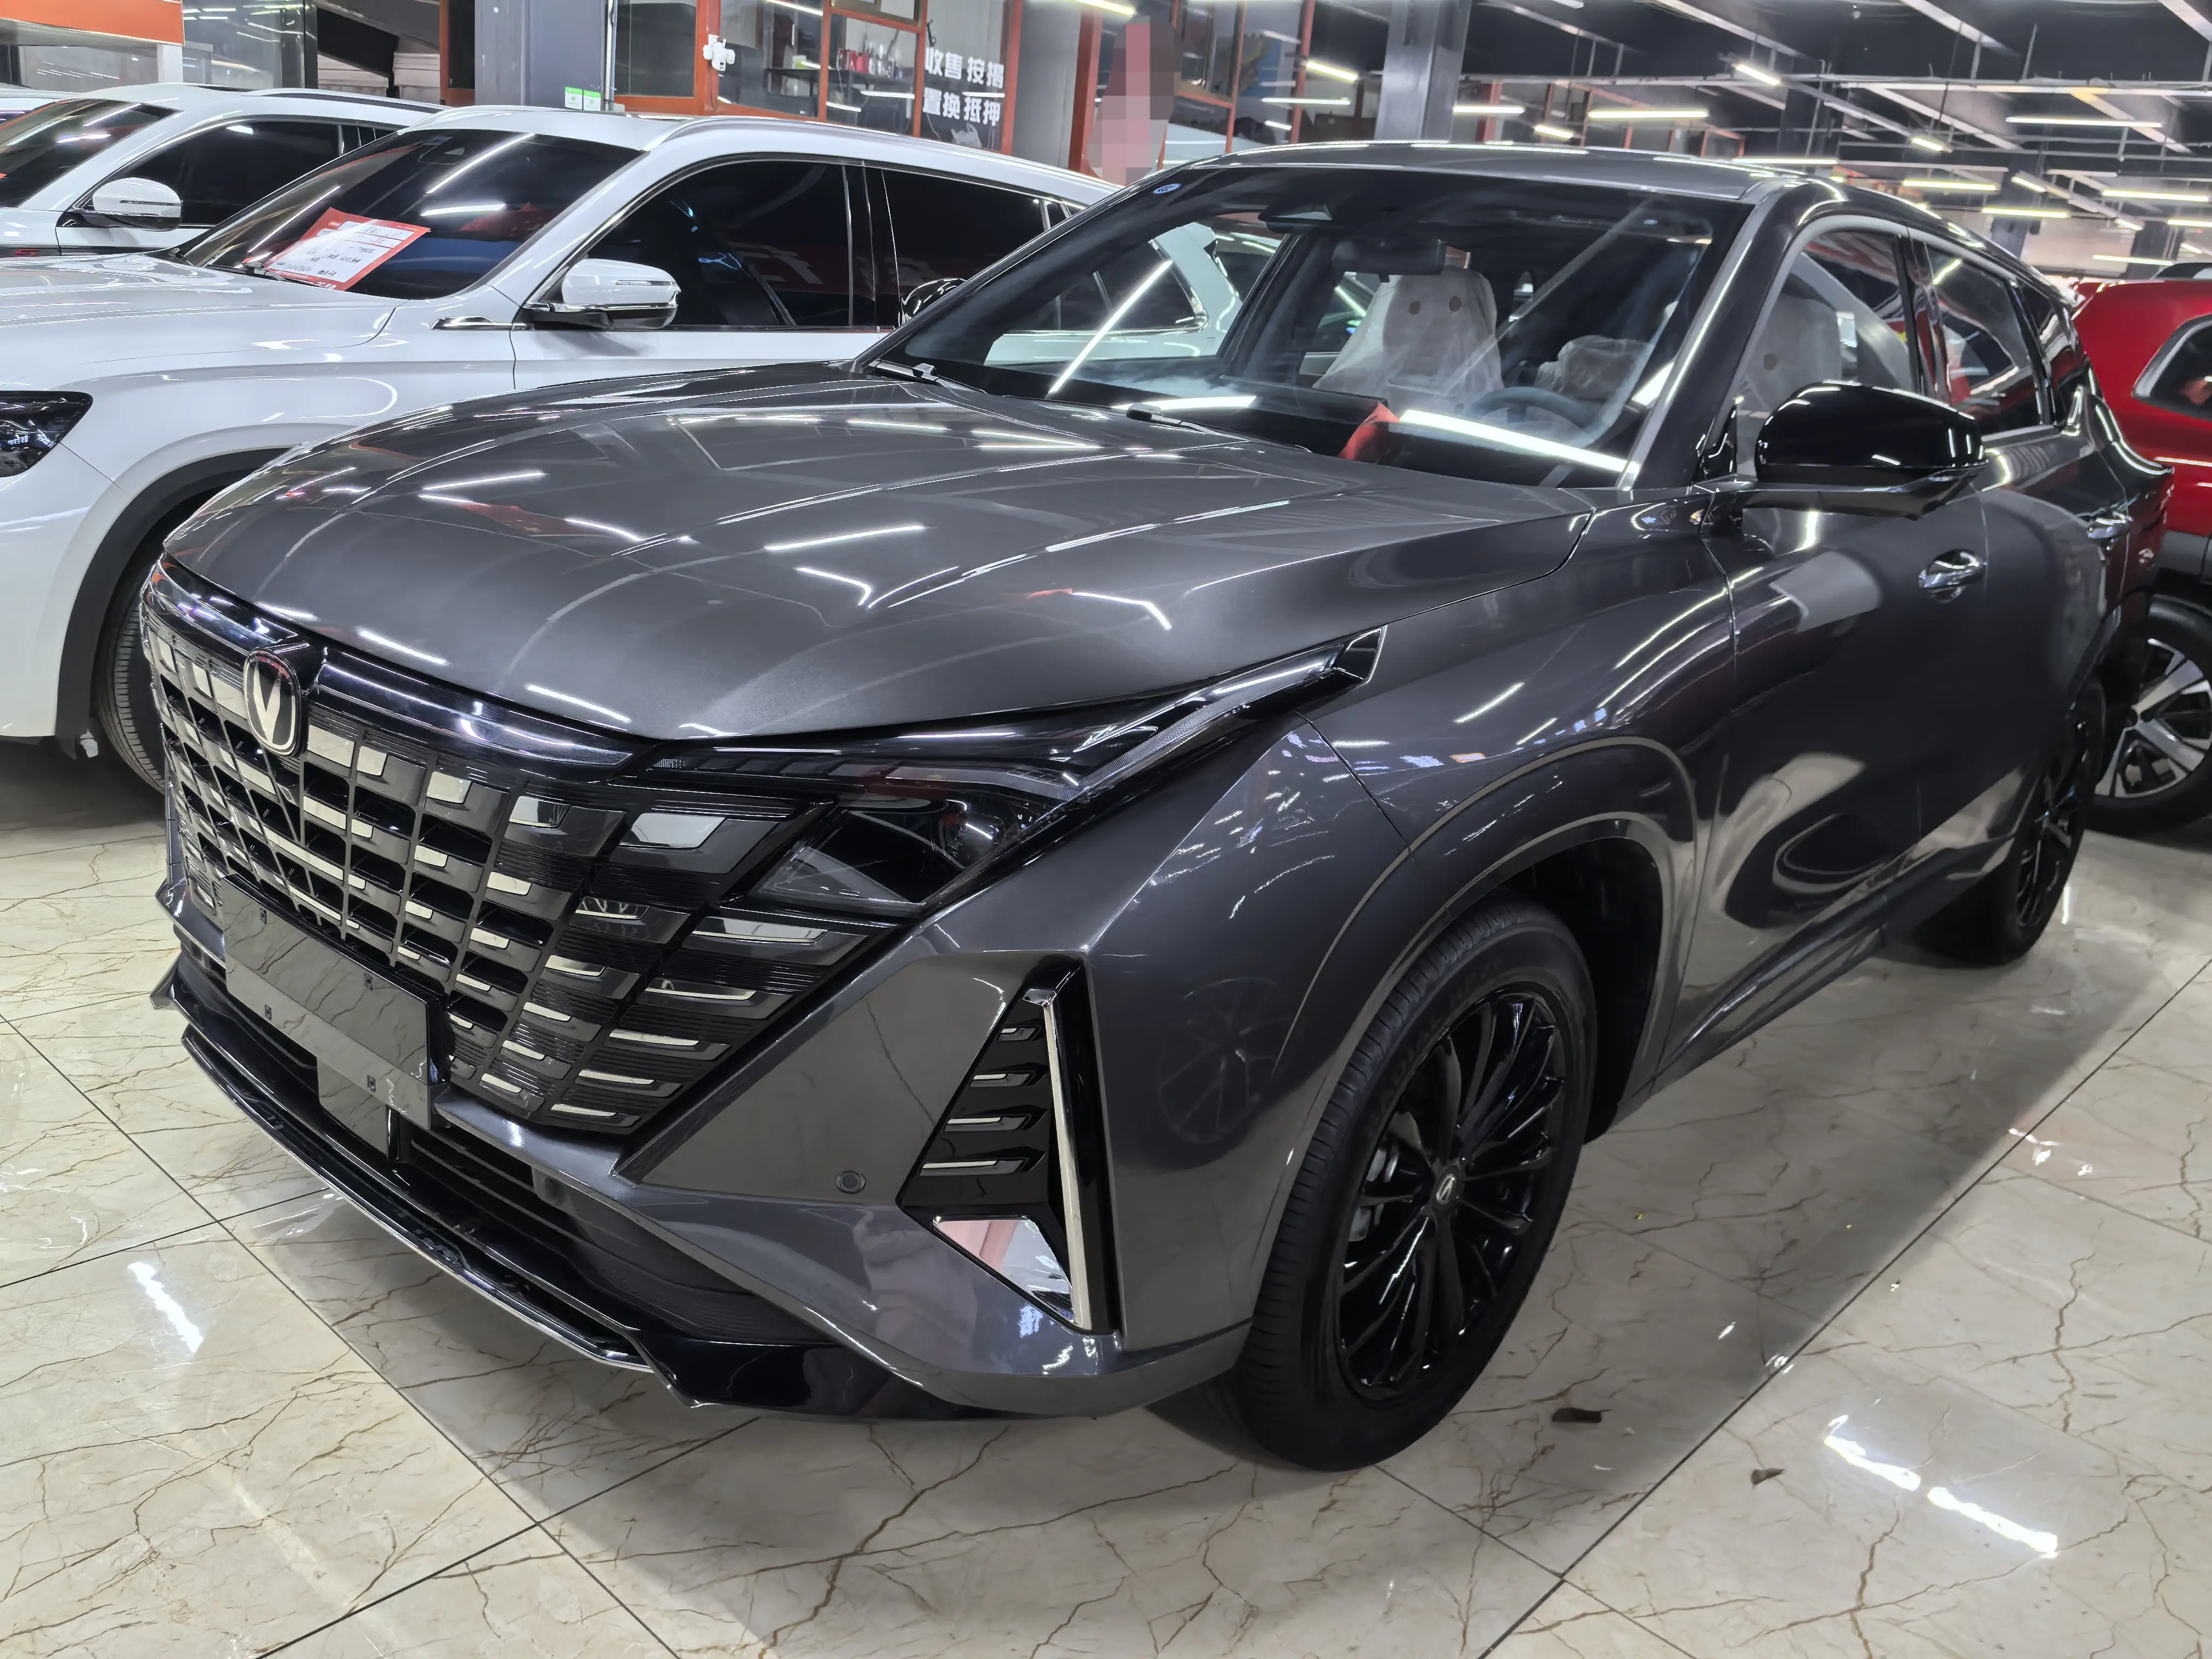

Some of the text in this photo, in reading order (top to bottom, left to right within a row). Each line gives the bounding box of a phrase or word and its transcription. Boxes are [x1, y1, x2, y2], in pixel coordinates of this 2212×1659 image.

[925, 48, 1004, 89] 收售 按揭
[922, 87, 1001, 126] 置换 抵押
